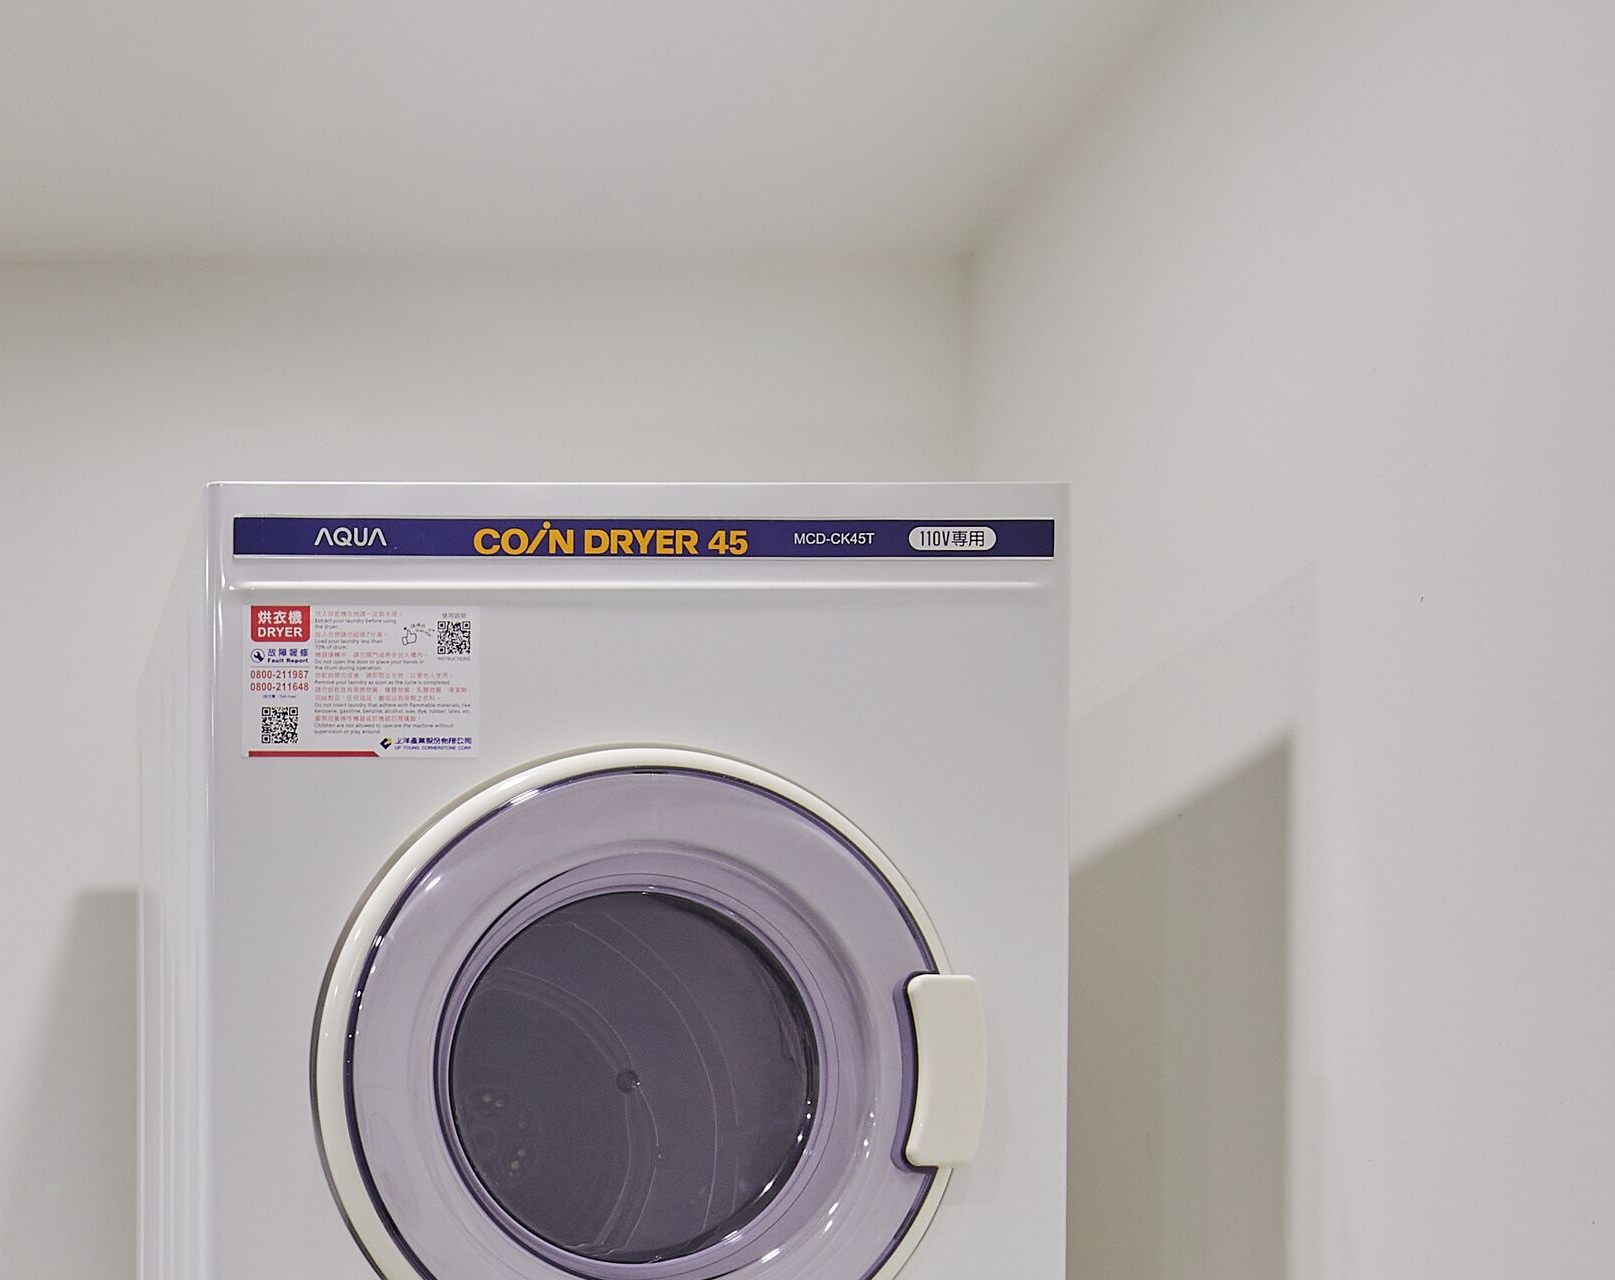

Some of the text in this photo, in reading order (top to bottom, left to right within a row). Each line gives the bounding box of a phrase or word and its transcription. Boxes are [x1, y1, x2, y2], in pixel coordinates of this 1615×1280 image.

[314, 526, 387, 546] AQUA
[473, 521, 748, 555] COIN DRYER 45
[794, 532, 875, 546] MCD-CK45T
[257, 610, 303, 625] 烘衣機
[257, 627, 303, 638] DRYER
[250, 670, 309, 679] 0800-211987
[250, 683, 309, 692] 0800-211648
